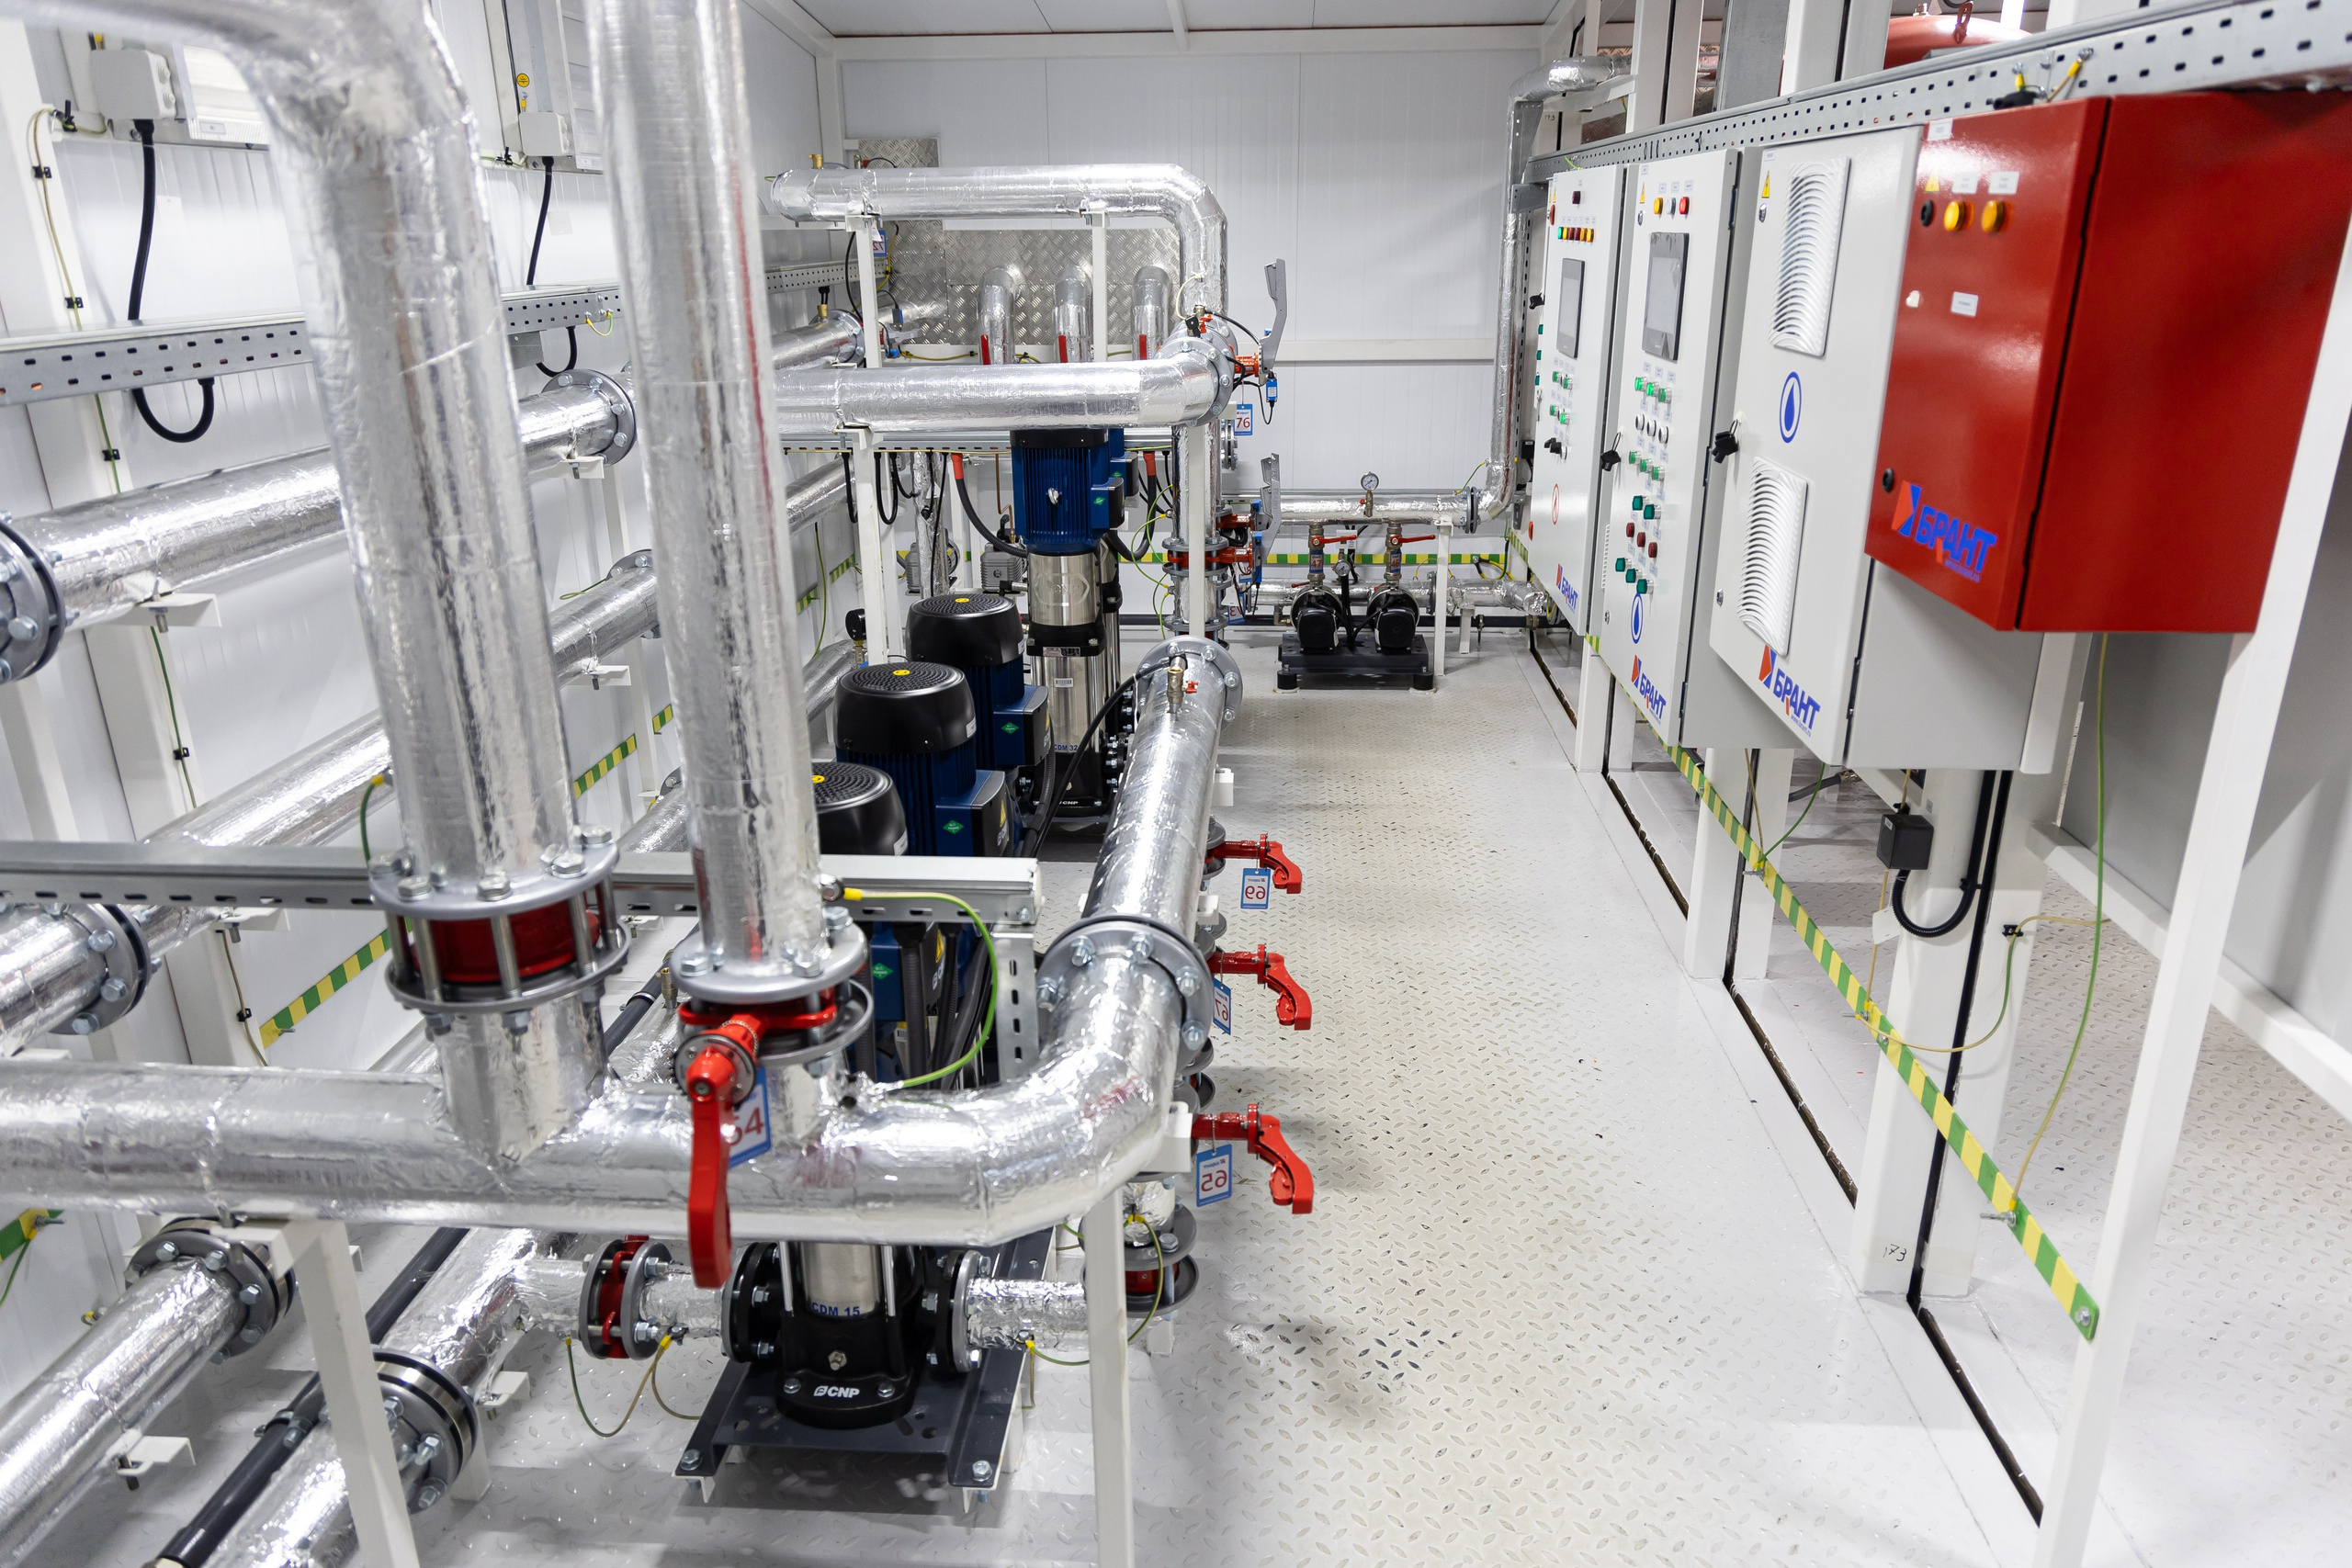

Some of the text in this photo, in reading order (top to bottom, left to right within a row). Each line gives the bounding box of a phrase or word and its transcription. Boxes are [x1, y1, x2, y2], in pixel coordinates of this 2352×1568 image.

[1236, 417, 1250, 428] 76
[1915, 504, 1997, 572] БРАНТ
[1311, 559, 1321, 569] 47
[1391, 559, 1400, 568] 46
[1561, 576, 1578, 610] БРАНТ
[1639, 672, 1667, 720] БРАНТ
[1772, 668, 1821, 730] БРАНТ
[810, 1302, 860, 1317] CDM 15
[827, 1386, 860, 1398] CNP
